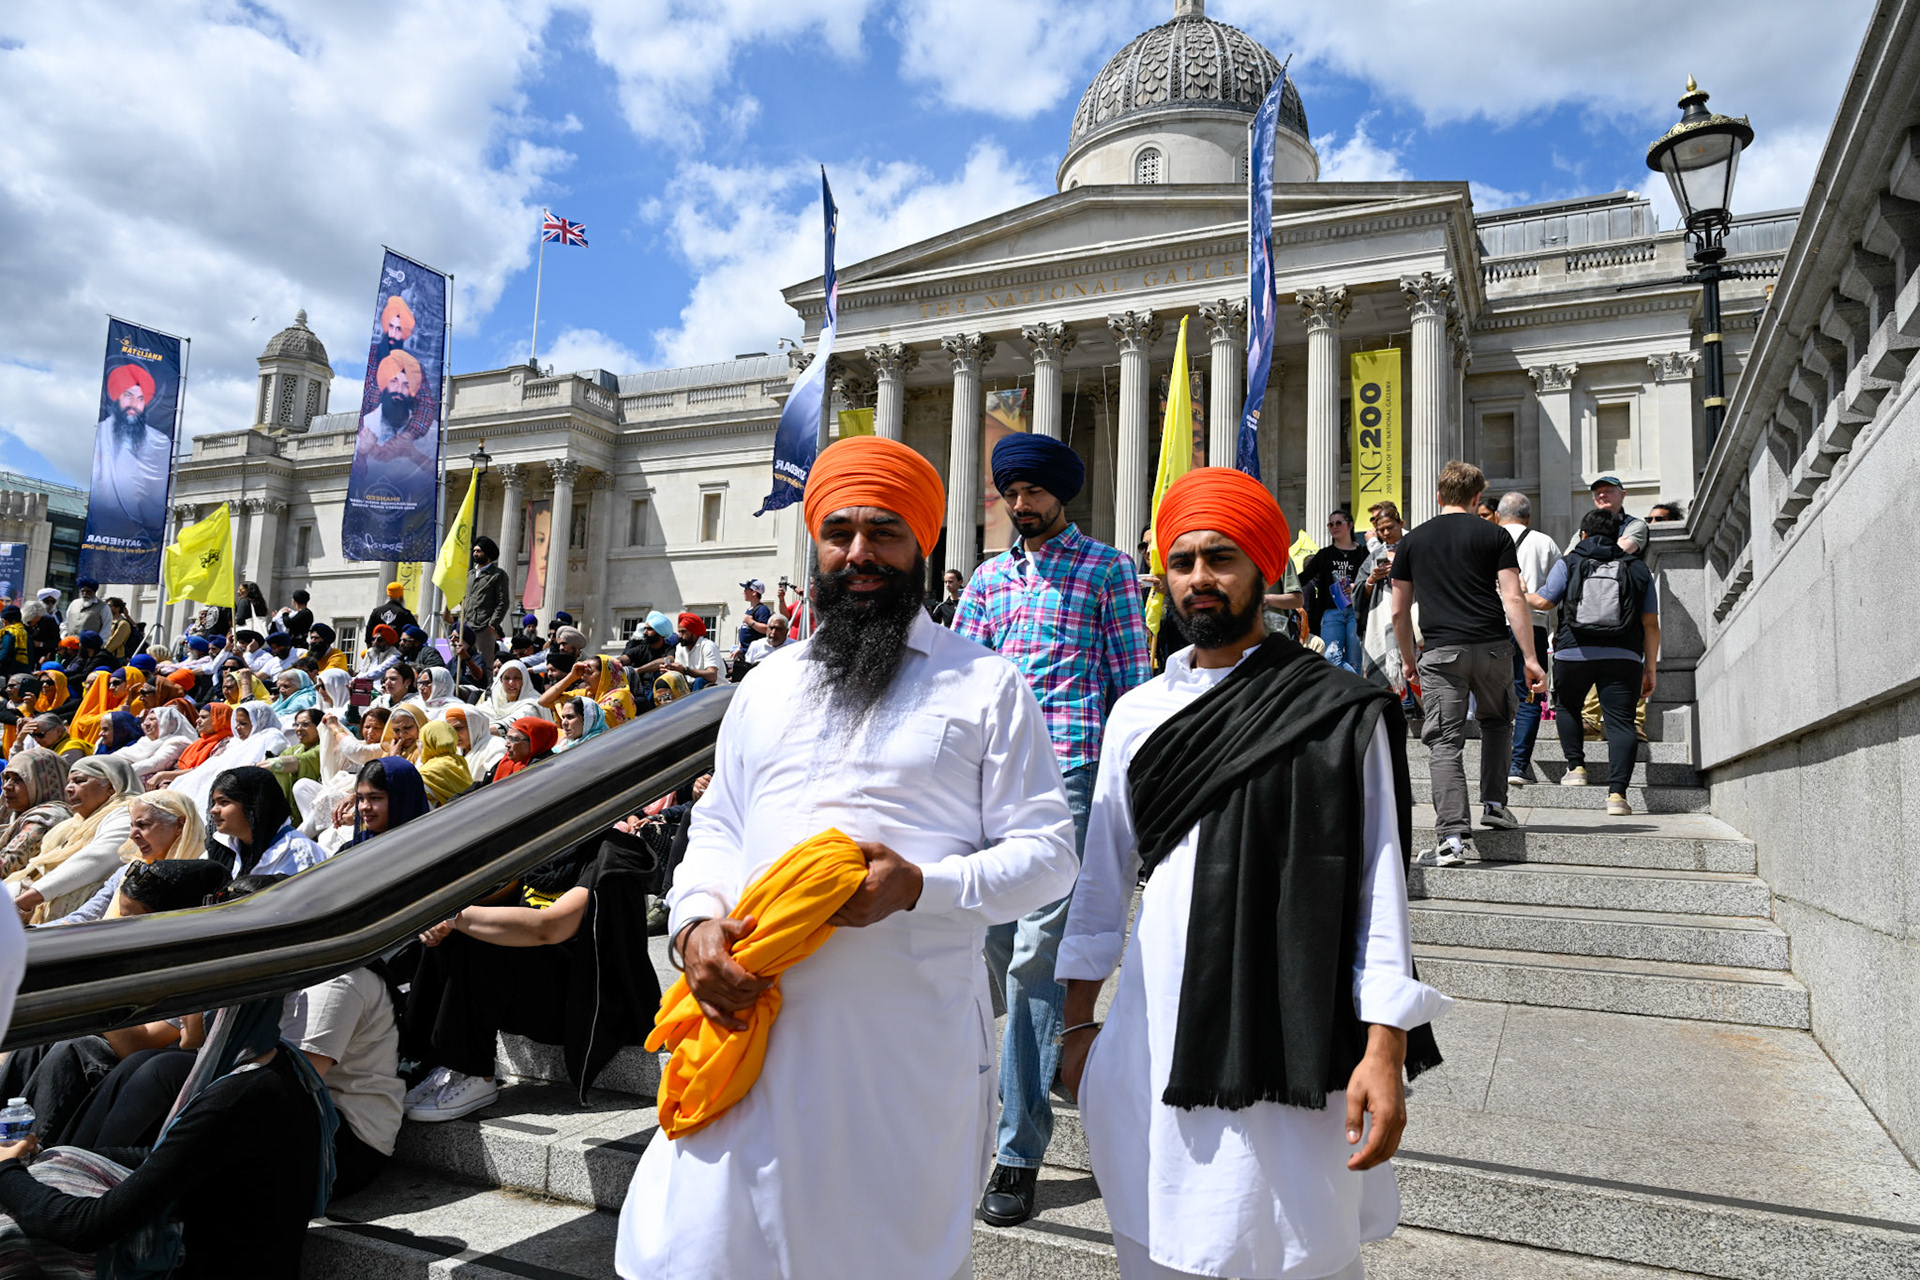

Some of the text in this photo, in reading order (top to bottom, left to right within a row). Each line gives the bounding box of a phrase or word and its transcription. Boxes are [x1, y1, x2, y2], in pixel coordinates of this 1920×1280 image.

[919, 254, 1279, 319] THE NATIONAL GALLE
[1359, 382, 1382, 494] NG200
[400, 562, 412, 592] NG
